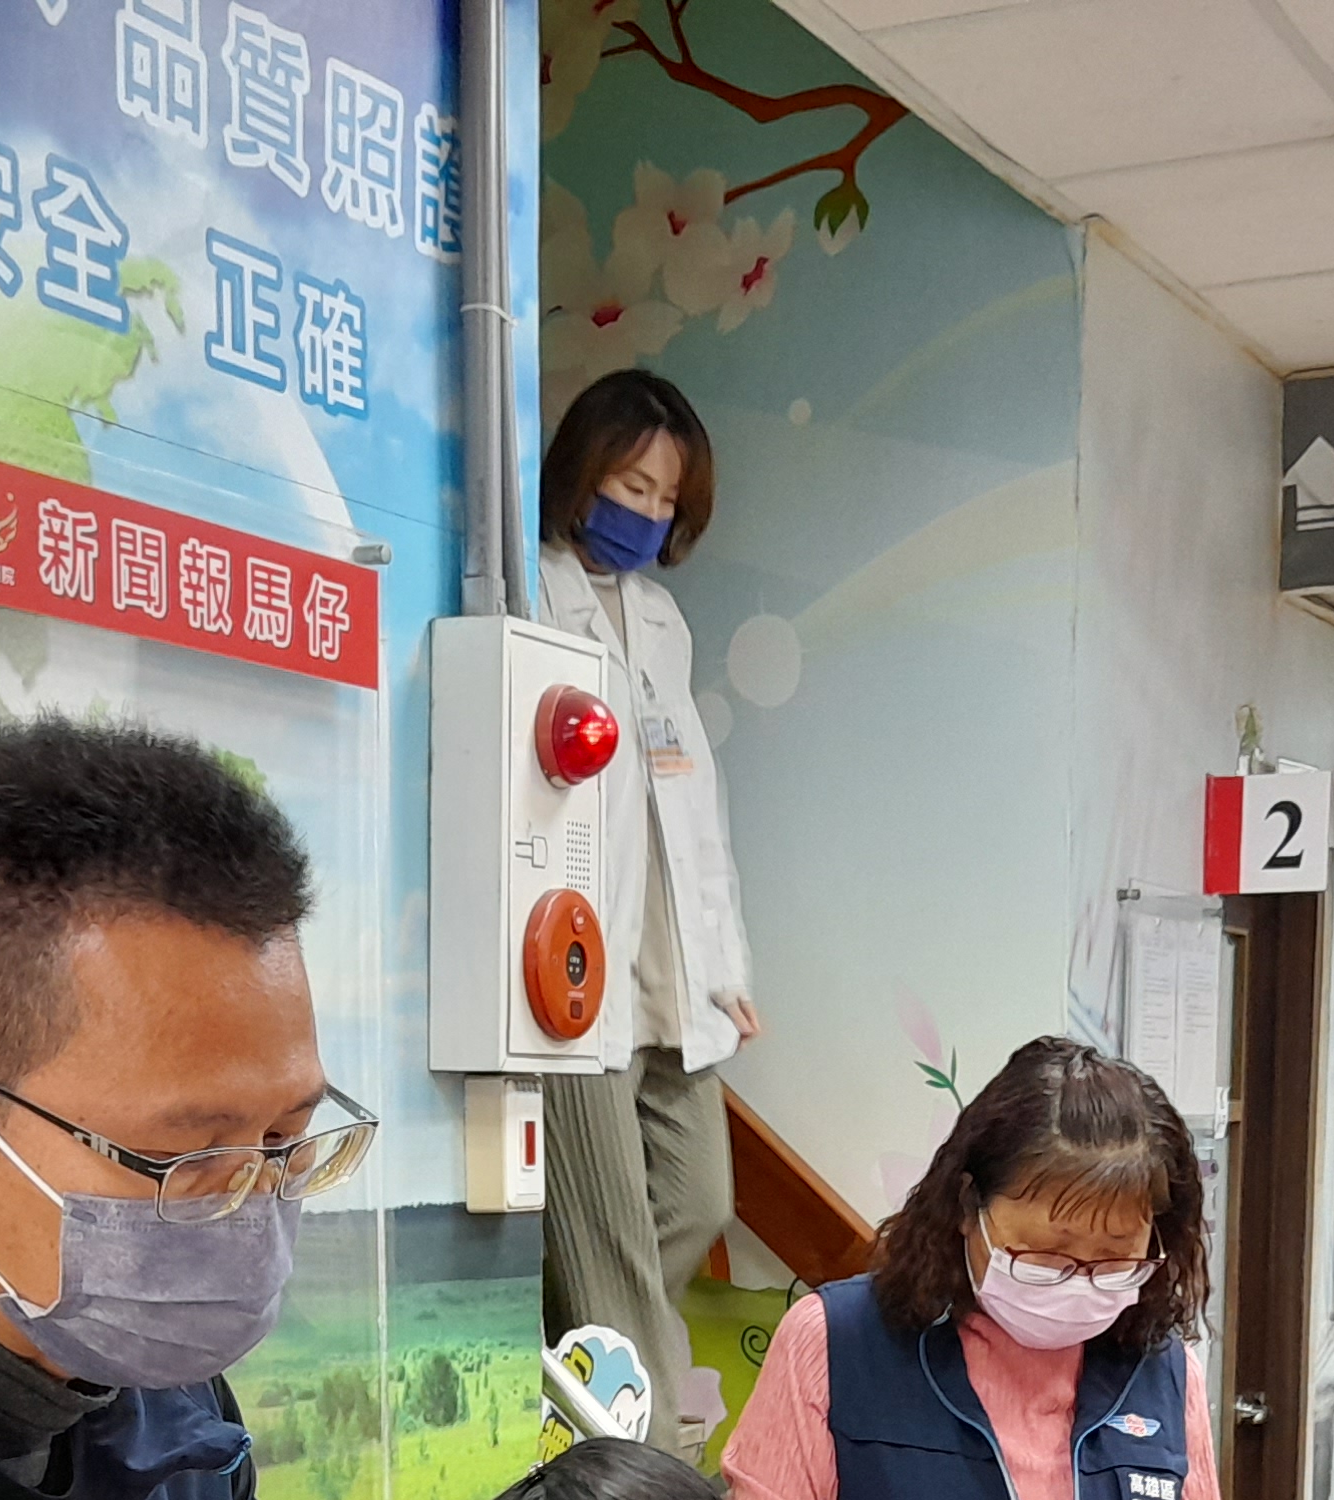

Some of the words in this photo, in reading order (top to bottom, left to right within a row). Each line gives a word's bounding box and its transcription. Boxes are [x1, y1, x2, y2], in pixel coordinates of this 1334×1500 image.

[208, 235, 369, 412] 正確
[37, 498, 351, 661] 新聞報馬仔
[1261, 800, 1305, 871] 2
